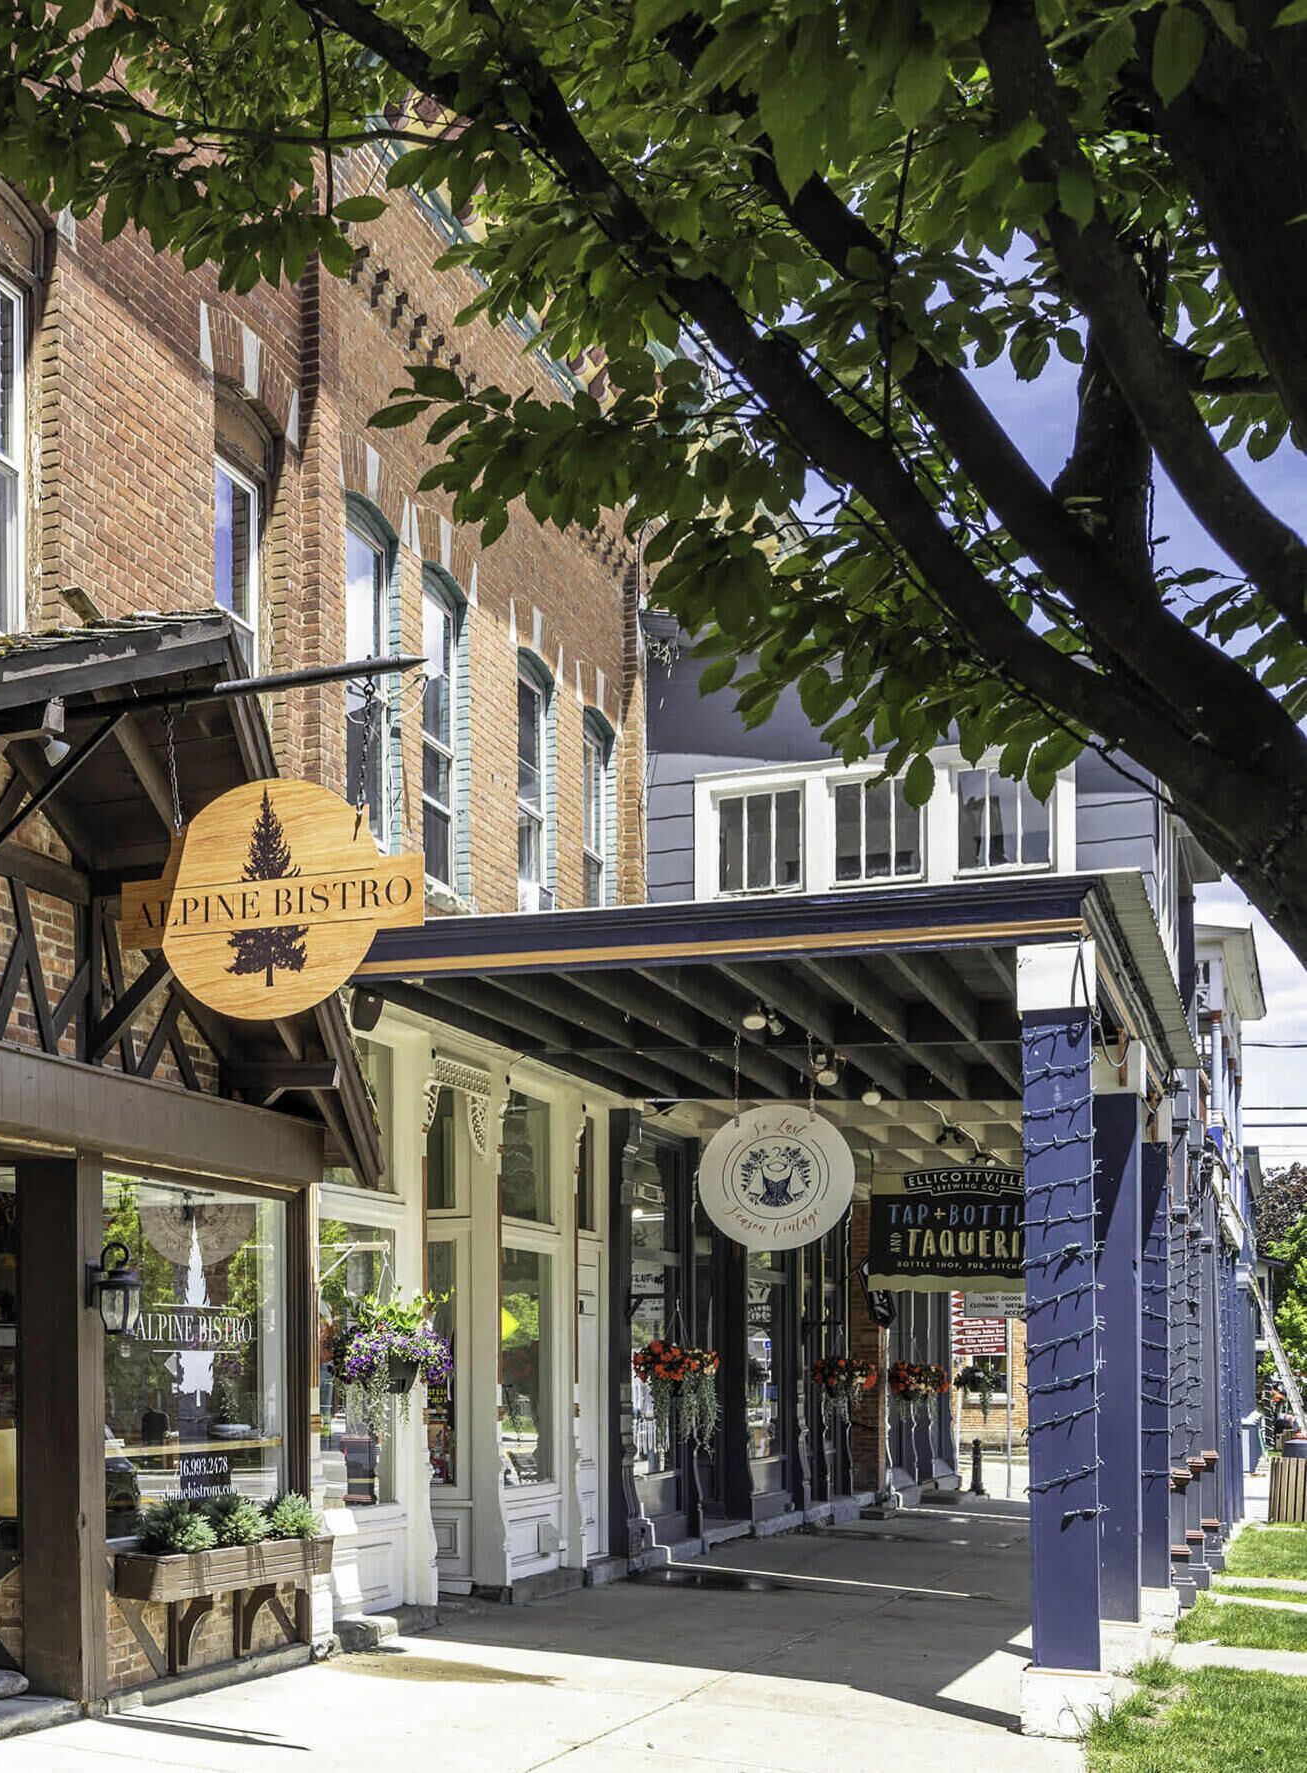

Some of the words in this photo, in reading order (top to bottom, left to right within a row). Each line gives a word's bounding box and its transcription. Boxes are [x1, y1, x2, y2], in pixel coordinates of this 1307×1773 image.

[140, 890, 260, 929] ALPINE
[274, 875, 412, 917] BISTRO
[750, 1122, 768, 1138] So
[776, 1118, 807, 1136] Last
[908, 1172, 1025, 1187] ELLICOTTVILLE
[936, 1182, 977, 1192] BREWING
[722, 1205, 767, 1235] Season
[773, 1207, 821, 1239] Vintage
[888, 1203, 929, 1225] TAP
[949, 1204, 1023, 1226] BOTTL
[890, 1232, 903, 1253] AND
[907, 1228, 1026, 1259] TAQUERI
[135, 1312, 194, 1342] ALPINE
[199, 1315, 253, 1345] BISTRO
